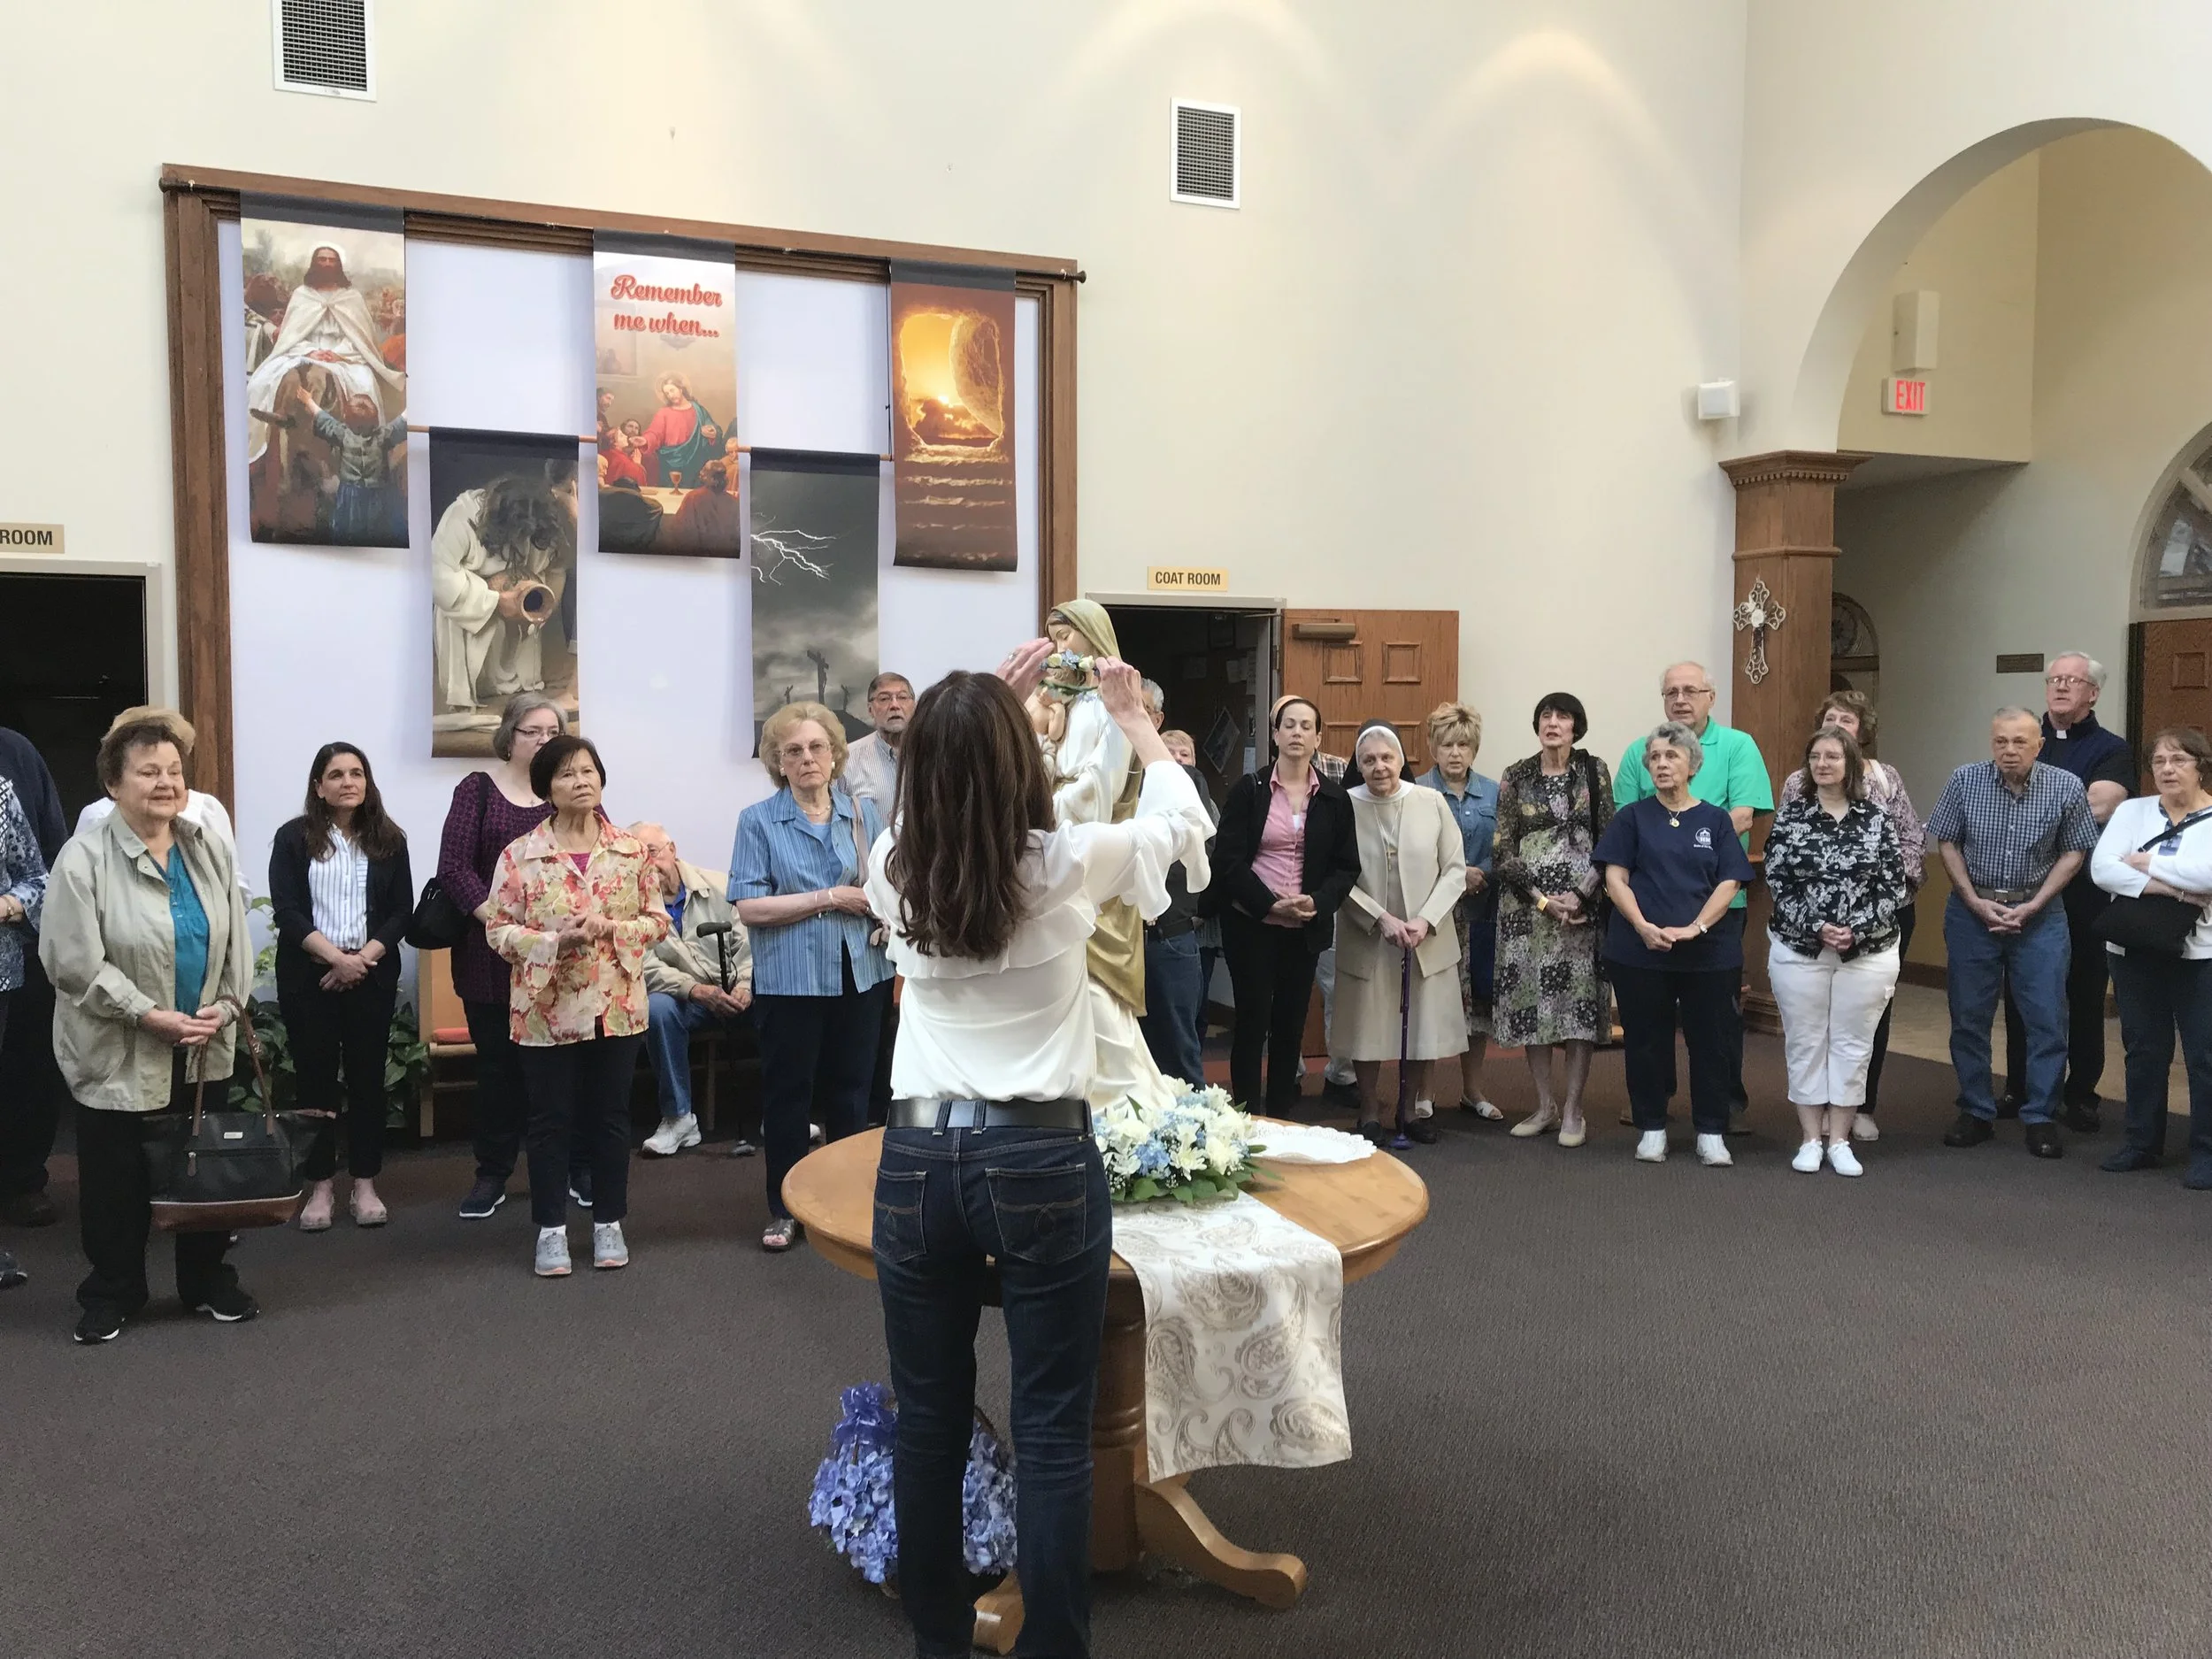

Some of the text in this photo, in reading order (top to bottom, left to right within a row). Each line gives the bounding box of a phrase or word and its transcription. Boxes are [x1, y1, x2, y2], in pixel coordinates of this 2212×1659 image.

[611, 274, 723, 307] Remember
[614, 311, 719, 337] me when...
[1896, 380, 1925, 411] EXIT
[0, 529, 53, 546] ROOM
[1155, 571, 1221, 586] COAT ROOM
